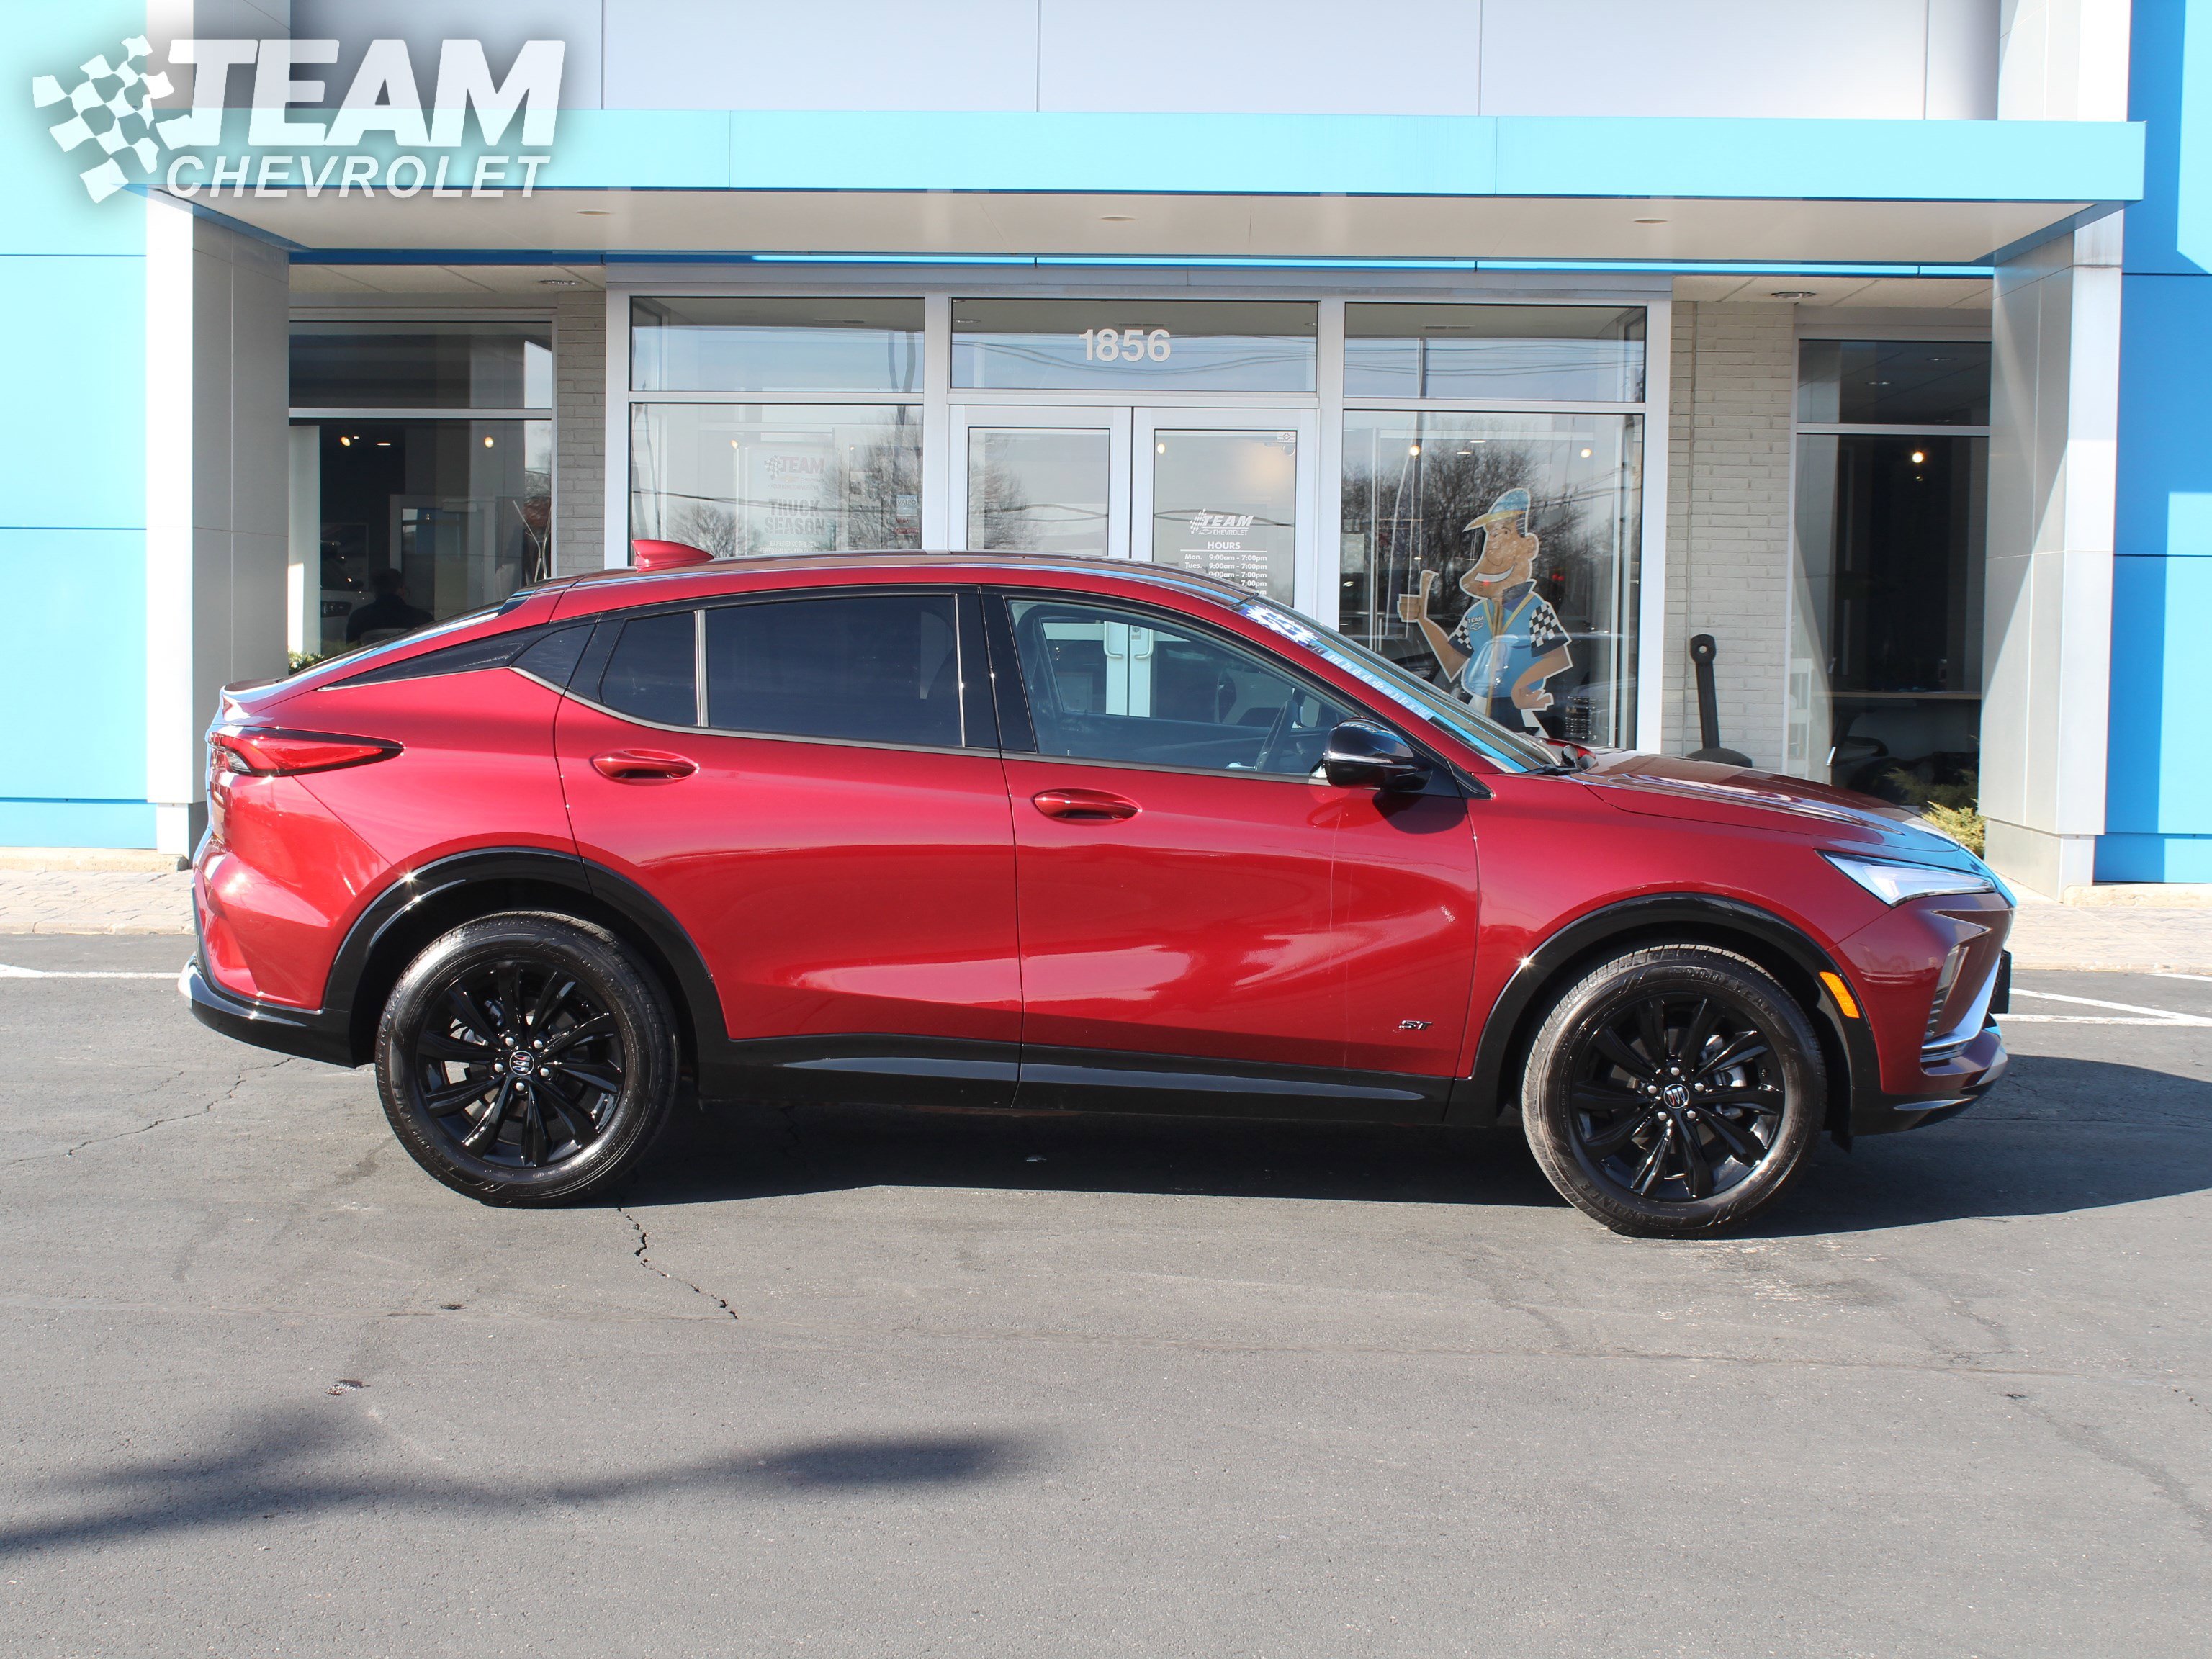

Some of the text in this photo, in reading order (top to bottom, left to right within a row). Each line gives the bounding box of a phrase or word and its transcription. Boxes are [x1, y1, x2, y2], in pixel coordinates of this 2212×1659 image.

[1079, 328, 1171, 362] 1856
[780, 456, 824, 474] TEAM
[768, 498, 820, 517] TRUCK
[764, 516, 825, 535] SEASON
[1202, 515, 1254, 526] TEAM
[1241, 554, 1267, 563] 7:00pm
[1241, 580, 1267, 588] 7:00pm
[1398, 1020, 1432, 1030] ST
